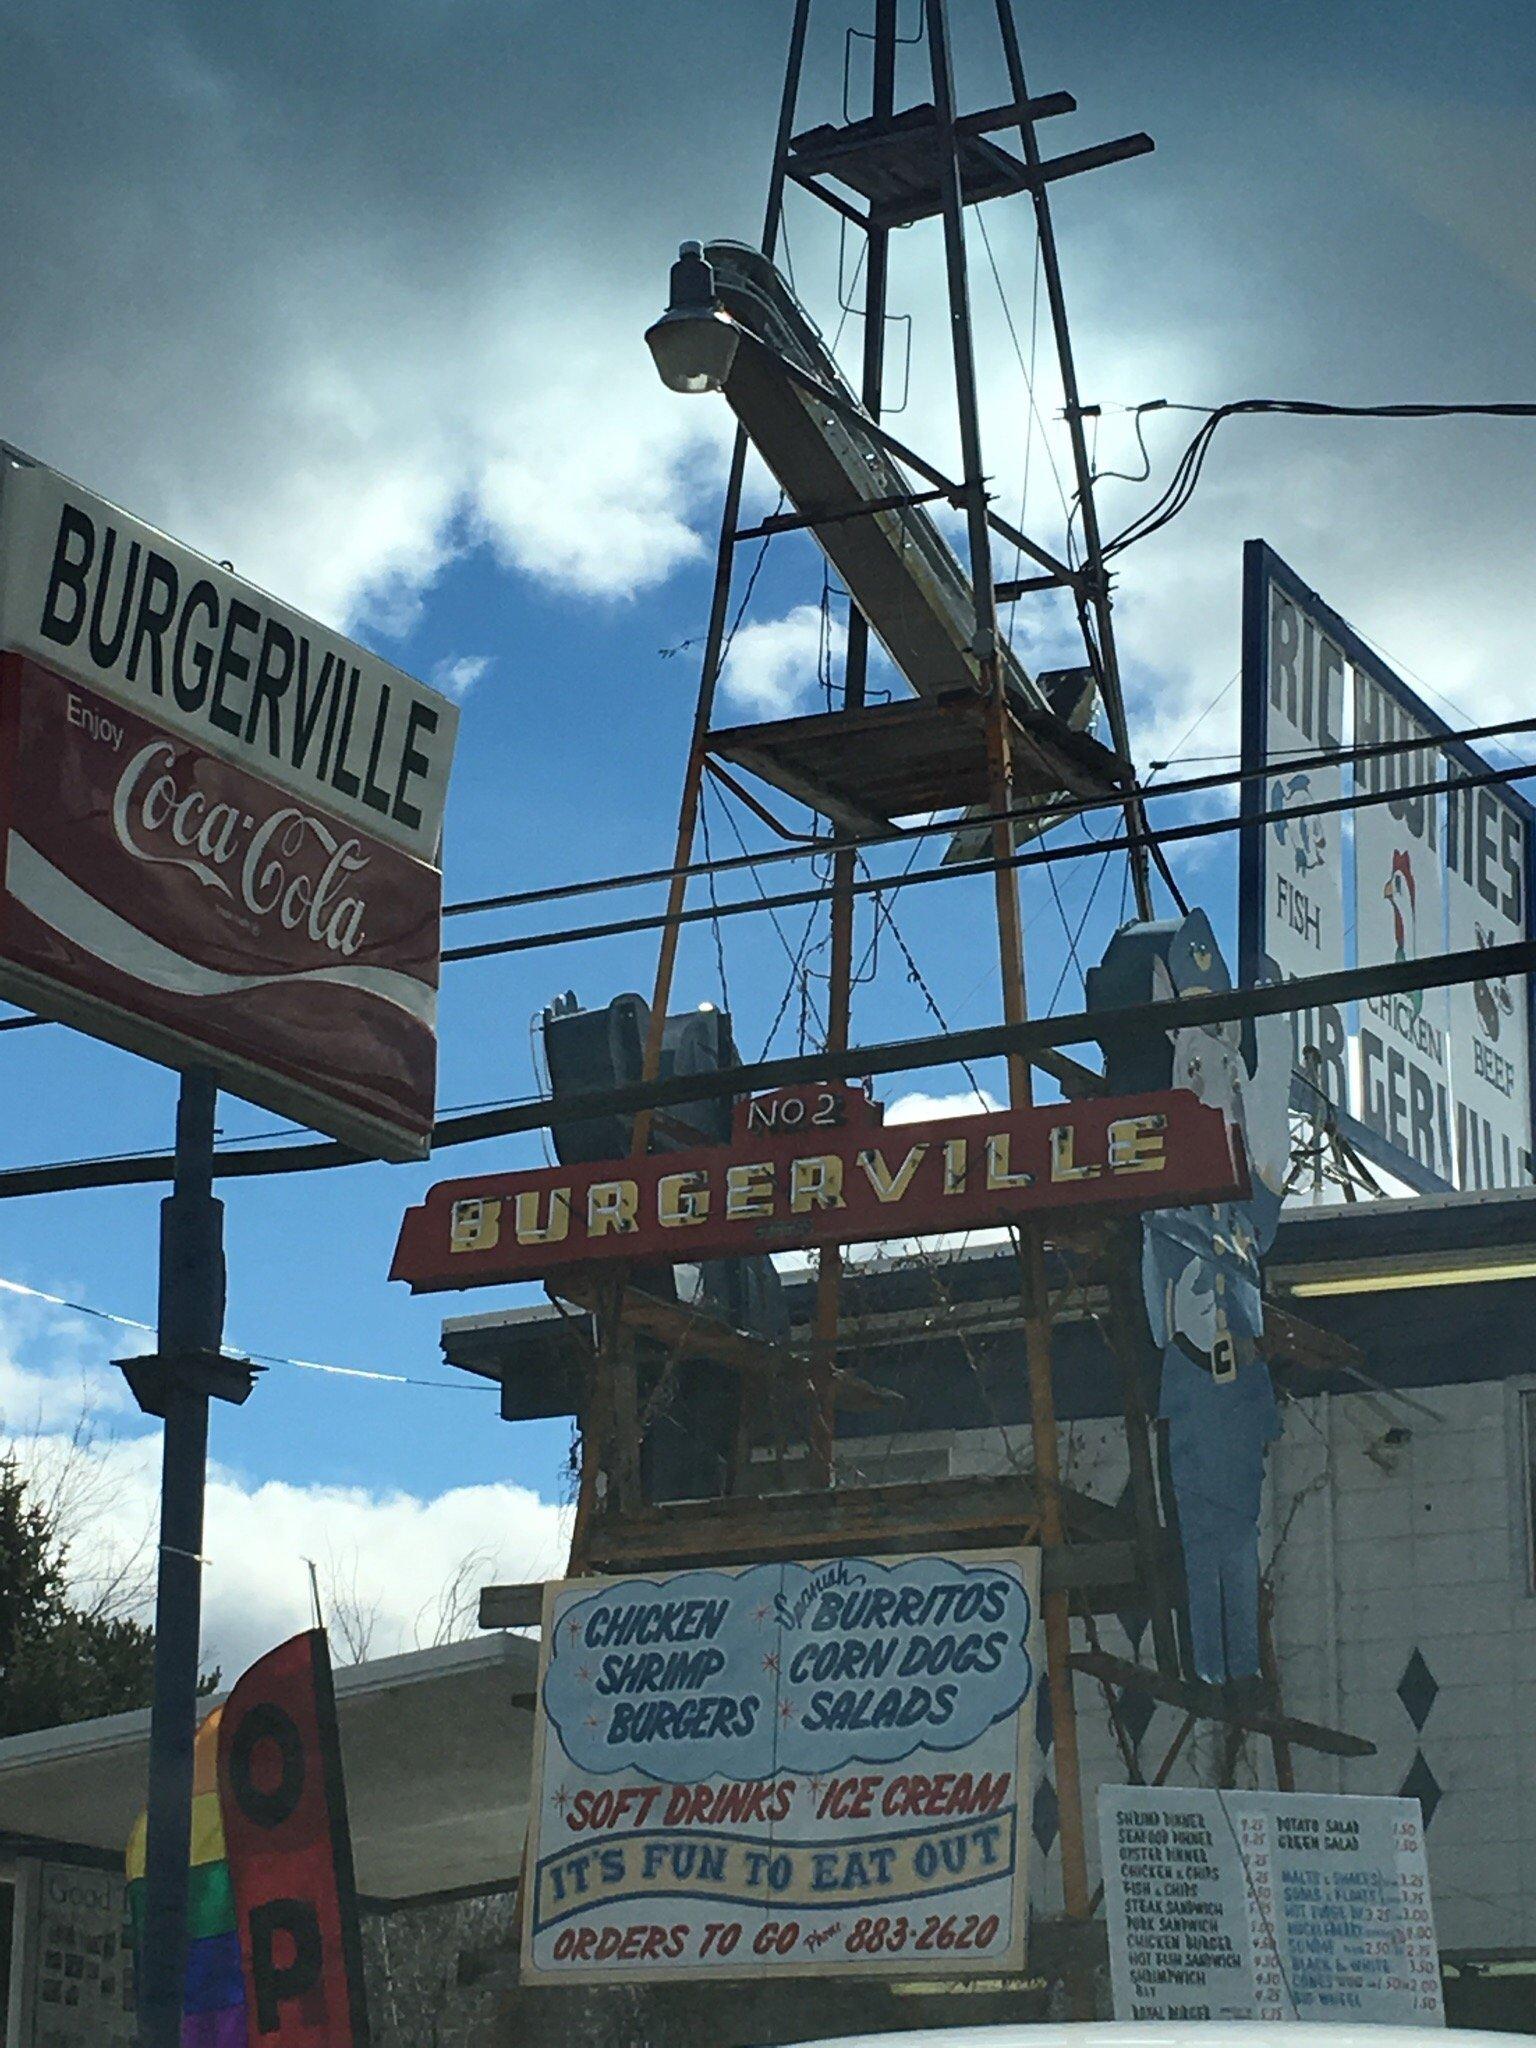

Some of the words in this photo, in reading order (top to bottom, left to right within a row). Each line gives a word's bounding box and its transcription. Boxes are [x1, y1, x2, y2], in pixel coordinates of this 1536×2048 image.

[40, 503, 439, 831] BURGERVILLE
[66, 693, 125, 752] Enjoy
[1276, 872, 1323, 950] FISH
[1472, 1035, 1514, 1098] BEEF
[811, 1093, 836, 1126] 2
[450, 1114, 1168, 1254] BURGERVILLE
[584, 1599, 730, 1649] CHICKEN
[810, 1580, 1010, 1632] BURRITOS
[596, 1648, 725, 1695] SHRIMP
[789, 1636, 899, 1684] CORN
[896, 1631, 1010, 1678] DOGS
[607, 1696, 760, 1745] BURGERS
[801, 1684, 959, 1732] SALADS
[566, 1784, 662, 1832] SOFT
[662, 1779, 797, 1827] DRINKS
[815, 1777, 883, 1820] ICE
[881, 1771, 1012, 1817] CREAM
[1118, 1828, 1169, 1845] SEAFOOD
[1172, 1830, 1213, 1846] DINNER
[1163, 1812, 1205, 1828] DINNER
[1276, 1816, 1320, 1832] POTATO
[1325, 1819, 1359, 1834] SALAD
[1278, 1834, 1320, 1850] GREEN
[1324, 1836, 1359, 1851] SALAD
[550, 1844, 626, 1901] IT'S
[641, 1841, 727, 1883] FUN
[745, 1854, 793, 1889] TO
[810, 1848, 897, 1891] EAT
[913, 1825, 1002, 1879] OUT
[1119, 1847, 1162, 1862] OYSTER
[1165, 1847, 1208, 1863] DINNER
[1120, 1863, 1172, 1879] CHICKEN
[1186, 1865, 1220, 1881] CHIPS
[1122, 1880, 1150, 1896] FISH
[1164, 1881, 1198, 1897] CHIPS
[1125, 1898, 1163, 1913] STEAK
[1165, 1900, 1224, 1916] SANDWICH
[553, 1923, 690, 1961] ORDERS
[699, 1922, 743, 1958] TO
[753, 1921, 800, 1956] GO
[1126, 1915, 1155, 1931] PORK
[1159, 1917, 1218, 1932] SANDWICH
[1126, 1933, 1180, 1949] CHICKEN
[1185, 1934, 1233, 1950] BURGER
